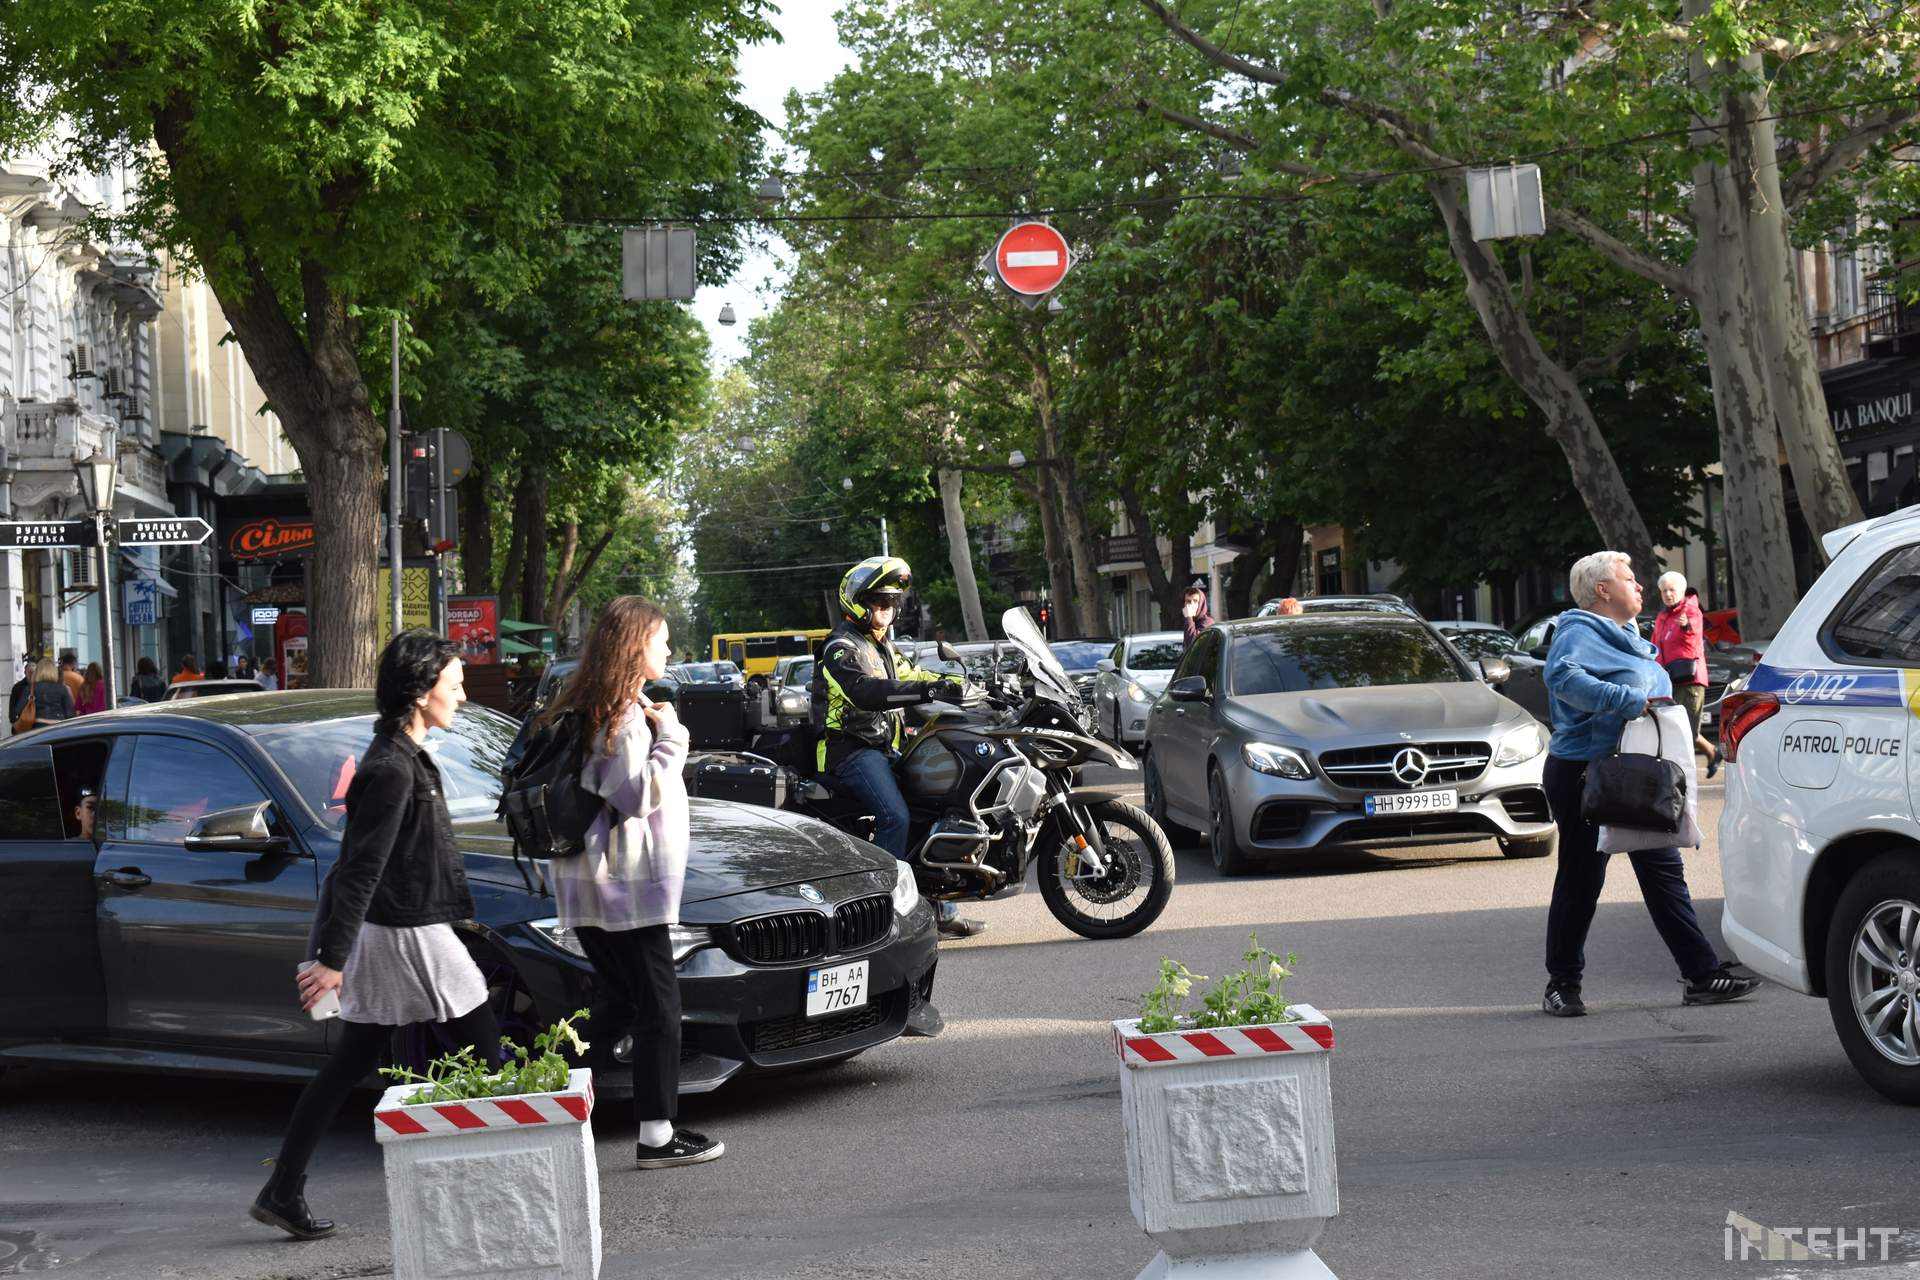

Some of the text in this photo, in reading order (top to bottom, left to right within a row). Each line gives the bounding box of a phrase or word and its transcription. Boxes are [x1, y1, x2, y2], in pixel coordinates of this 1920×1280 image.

[1834, 408, 1851, 432] LA
[16, 526, 65, 535] ВУЛИЦЯ
[132, 530, 189, 541] ГРЕЦЬКА
[138, 523, 182, 532] ВУЛИЦЯ
[241, 525, 314, 551] Сільп
[16, 535, 65, 544] ГРЕЦЬКА
[1811, 674, 1858, 701] 102
[1783, 735, 1900, 756] PATROL POLICE
[1396, 794, 1429, 811] 9999
[1432, 793, 1451, 808] BB
[821, 966, 863, 987] BH AA
[825, 985, 860, 1010] 7767
